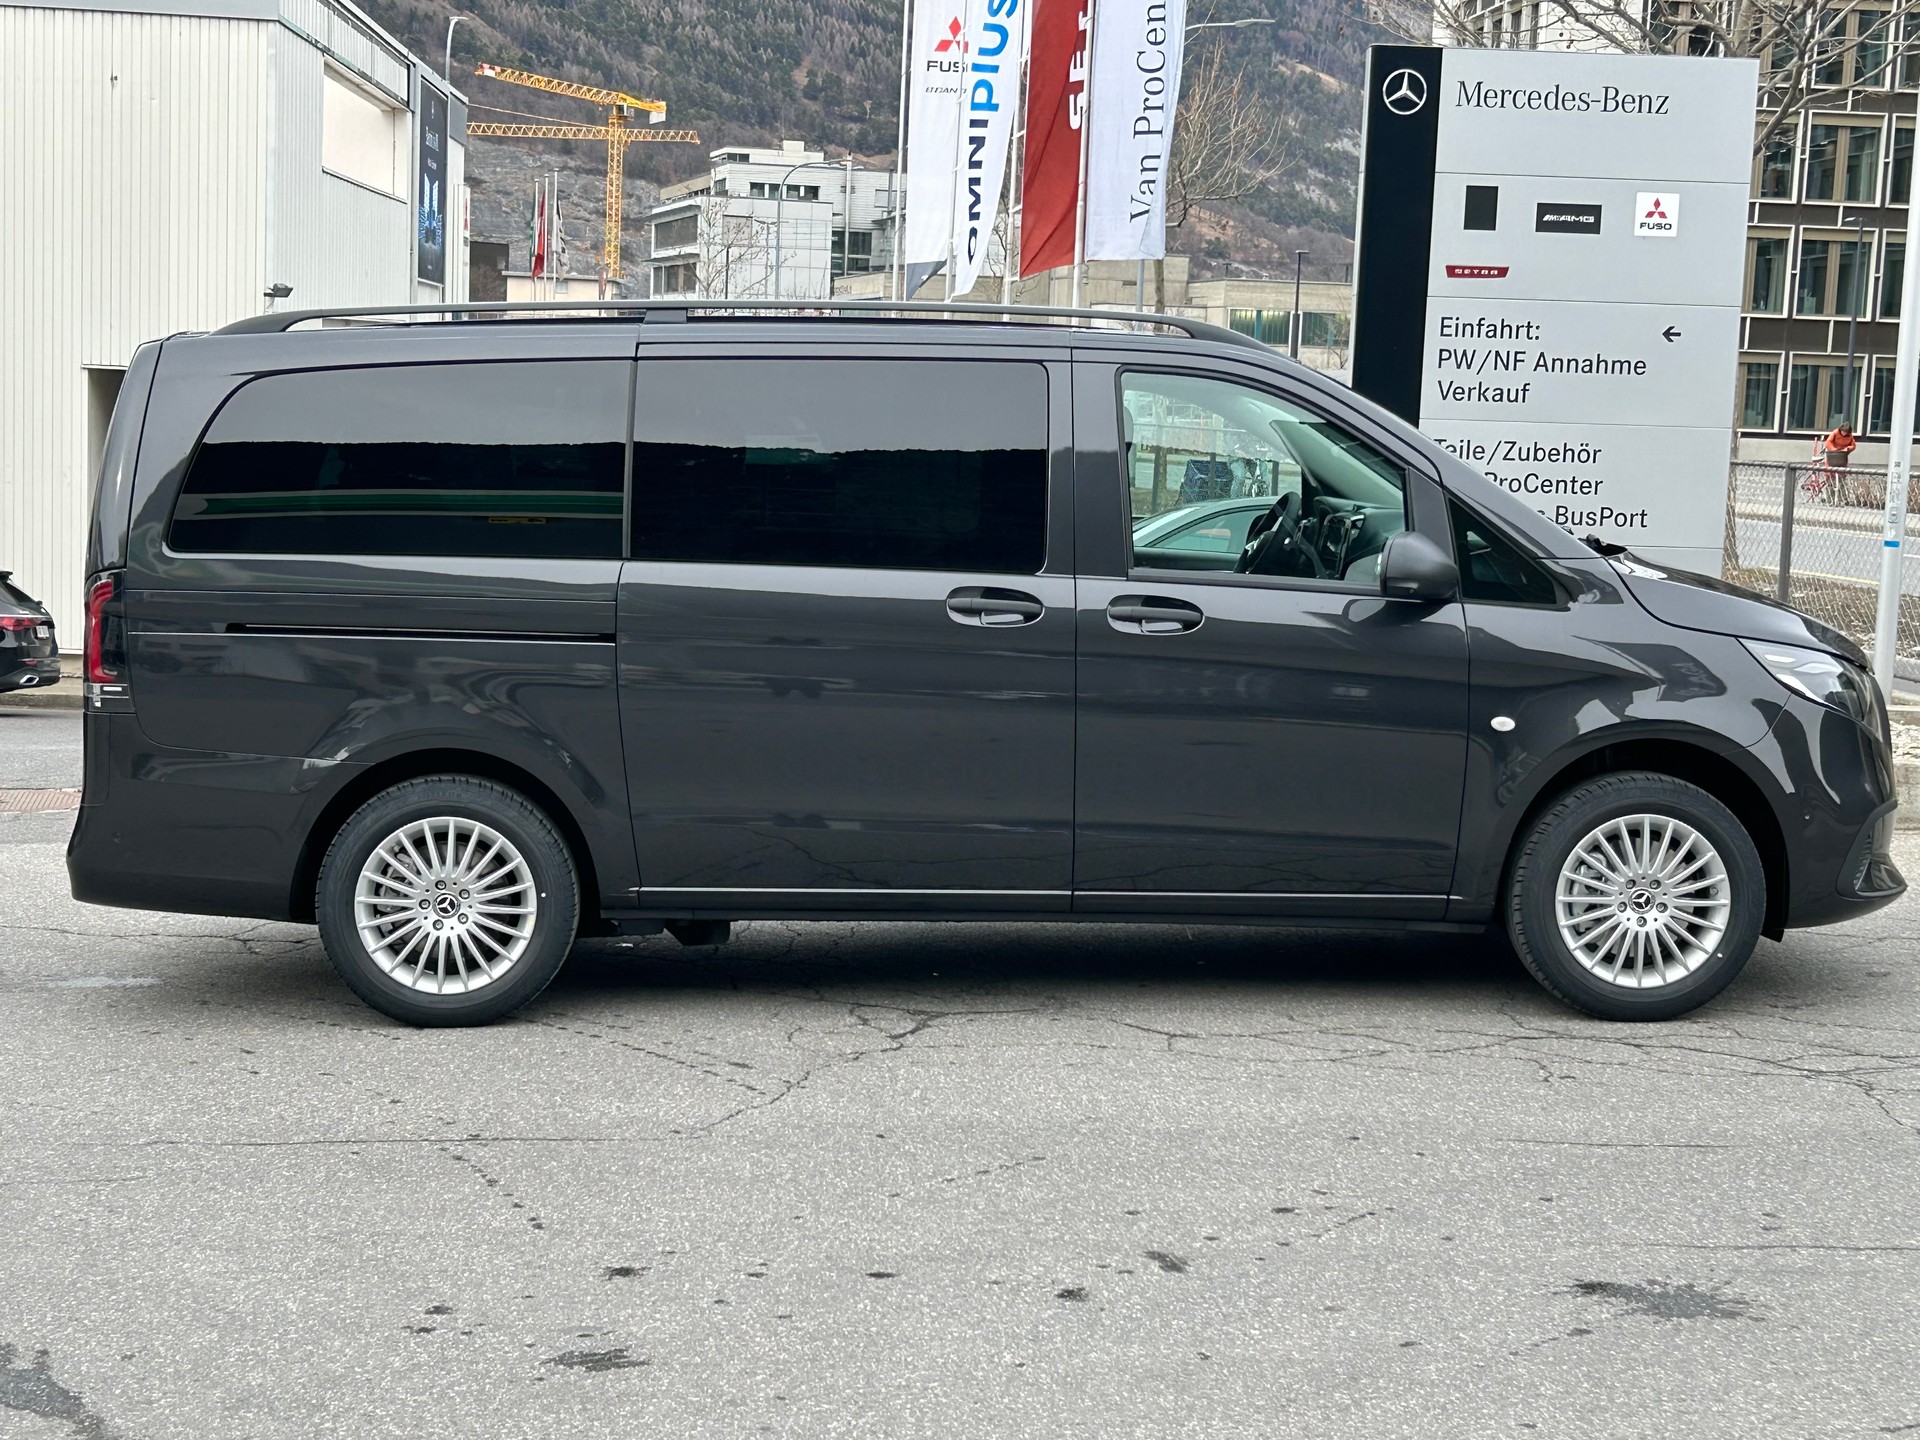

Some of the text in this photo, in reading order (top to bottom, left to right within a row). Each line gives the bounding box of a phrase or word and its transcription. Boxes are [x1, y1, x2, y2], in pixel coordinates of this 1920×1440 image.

[926, 60, 968, 73] FUS
[1455, 80, 1670, 115] Mercedes-Benz
[1129, 0, 1167, 223] Van ProCen
[1639, 222, 1672, 231] FUSO
[1439, 316, 1541, 341] Einfahrt:
[1437, 348, 1647, 376] PW/NF Annahme
[1437, 379, 1531, 404] Verkauf
[1555, 505, 1648, 528] BusPort
